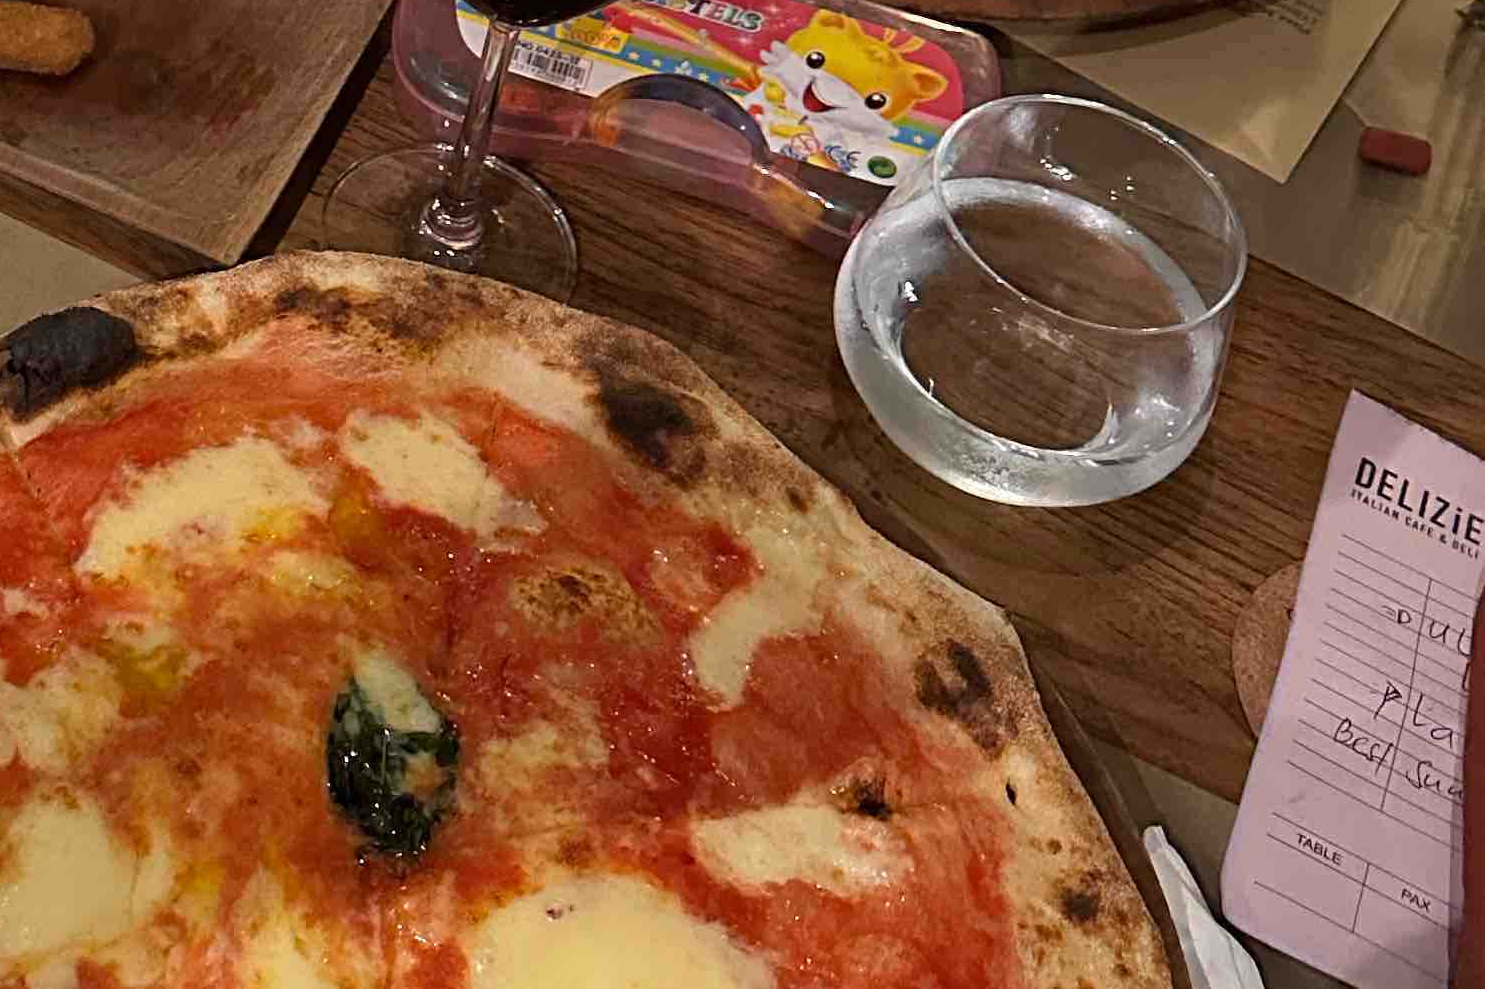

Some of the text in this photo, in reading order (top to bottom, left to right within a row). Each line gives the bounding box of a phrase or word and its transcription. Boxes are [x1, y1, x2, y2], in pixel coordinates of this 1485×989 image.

[1350, 489, 1400, 520] ITALIAN
[1452, 540, 1480, 560] DELI
[1297, 833, 1345, 866] TABLE
[1401, 888, 1431, 912] PAX
